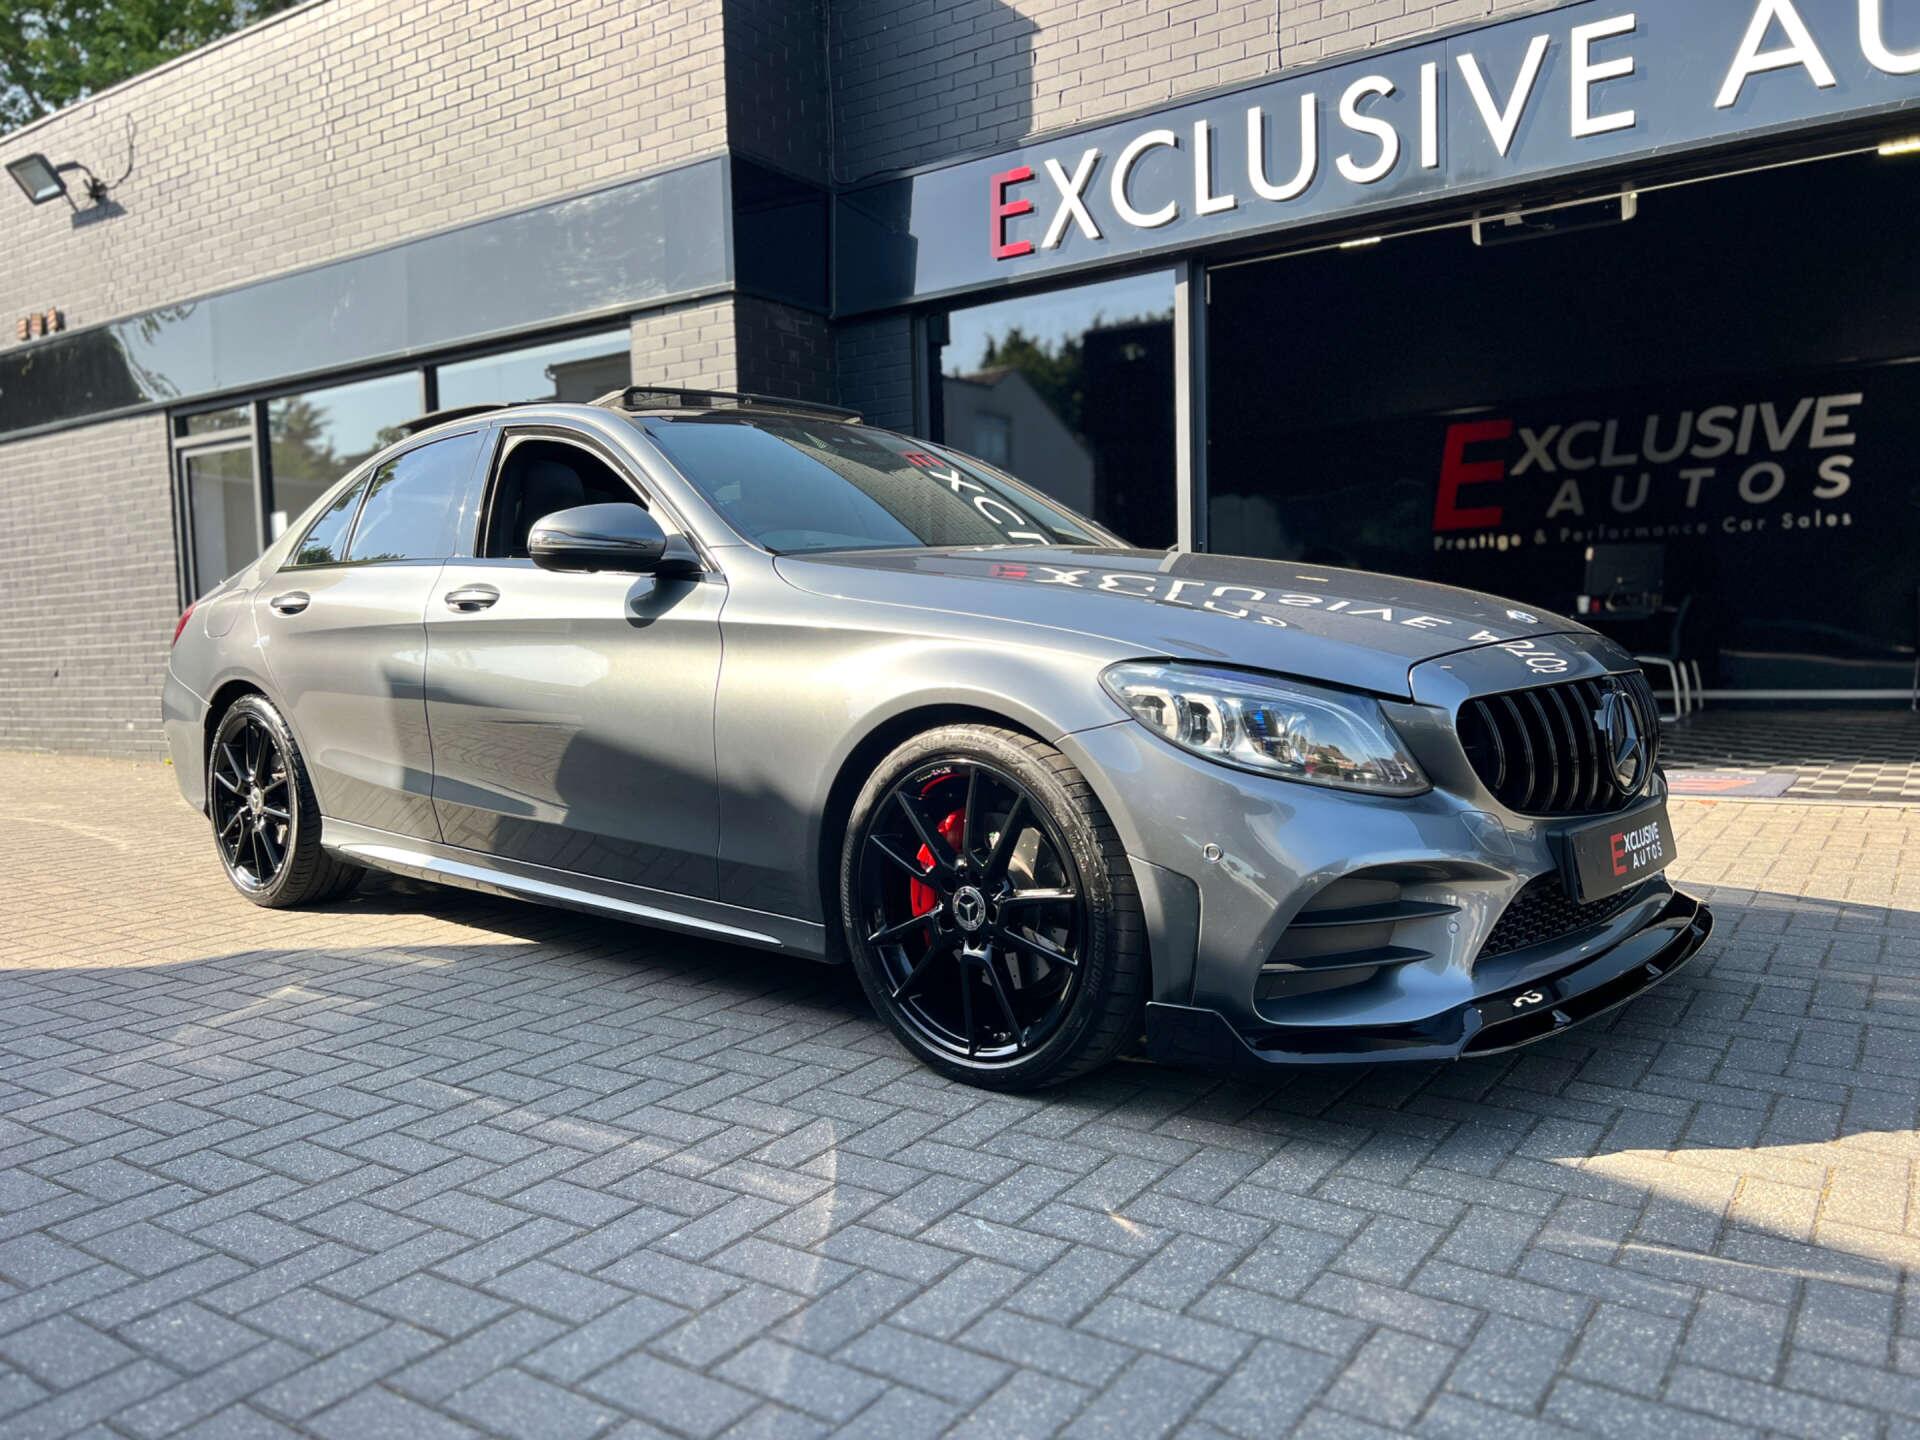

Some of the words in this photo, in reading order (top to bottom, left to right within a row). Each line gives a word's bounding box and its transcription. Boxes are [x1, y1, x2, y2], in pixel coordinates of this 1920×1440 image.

[990, 13, 1637, 260] EXCLUSIVE
[1432, 392, 1864, 532] EXCLUSIVE
[1546, 455, 1855, 519] AUTOS
[1434, 533, 1521, 551] Prestige
[1534, 528, 1547, 545] &
[1560, 523, 1707, 543] Performance
[1722, 516, 1766, 533] Car
[1781, 509, 1852, 530] Sales
[1610, 821, 1660, 876] EXCLUSIVE
[1633, 841, 1663, 869] AUTOS
